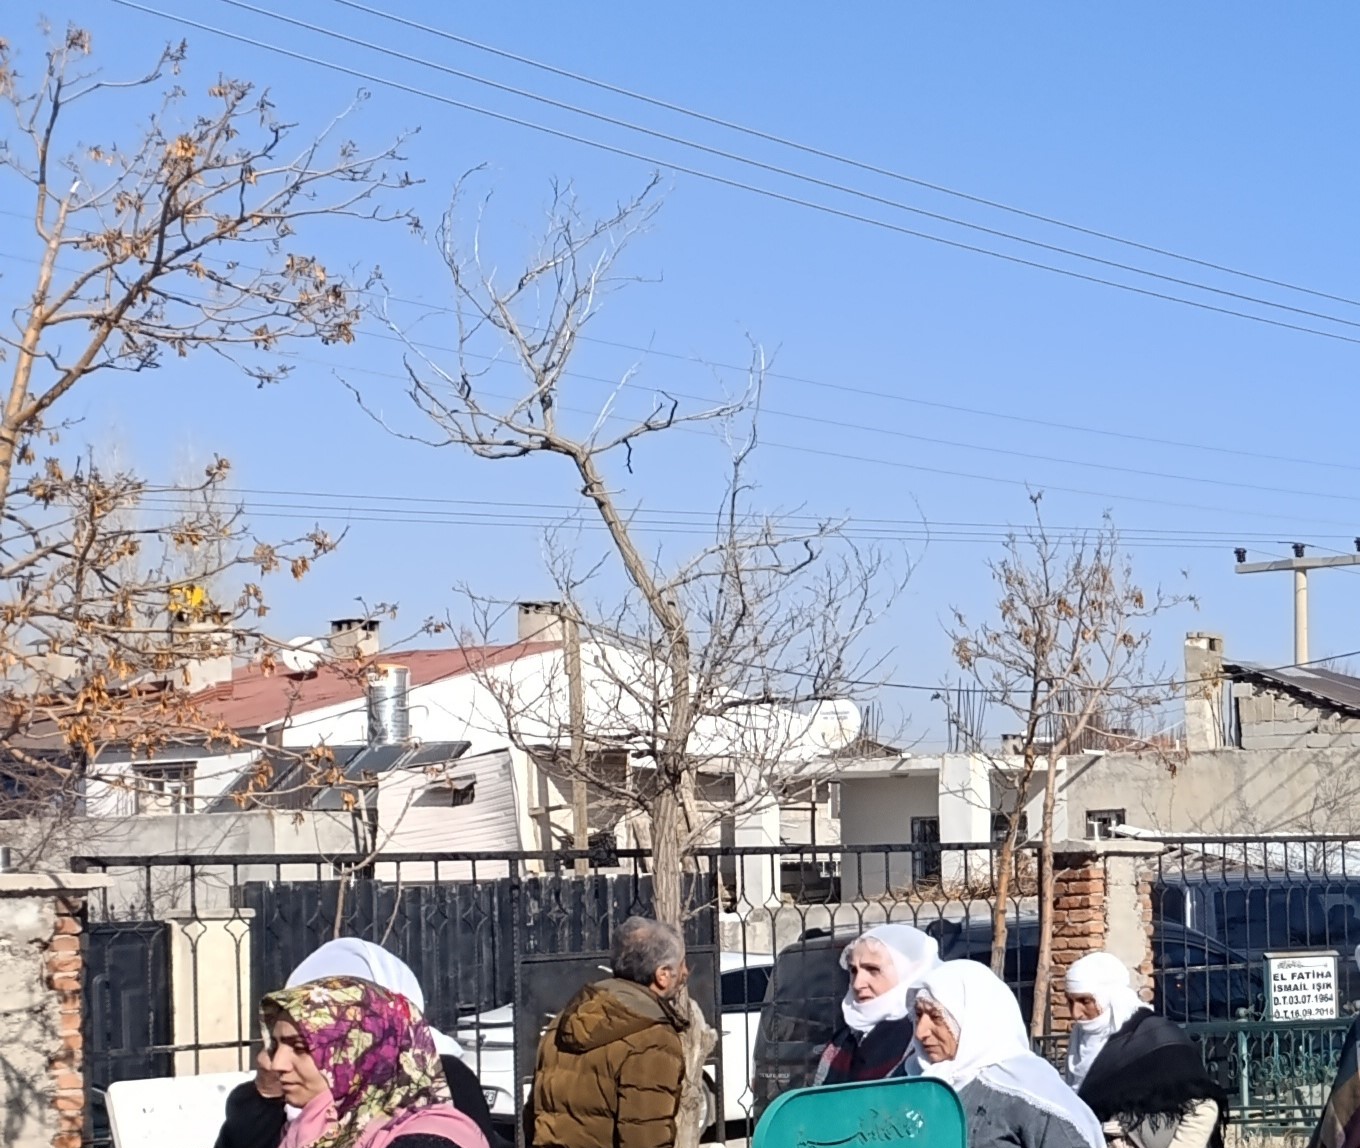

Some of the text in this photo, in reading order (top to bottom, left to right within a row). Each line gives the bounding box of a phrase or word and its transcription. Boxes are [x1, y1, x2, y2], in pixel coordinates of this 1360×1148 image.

[1273, 969, 1332, 982] EL FATİHA
[1273, 982, 1332, 993] İSMAİL IŞIK
